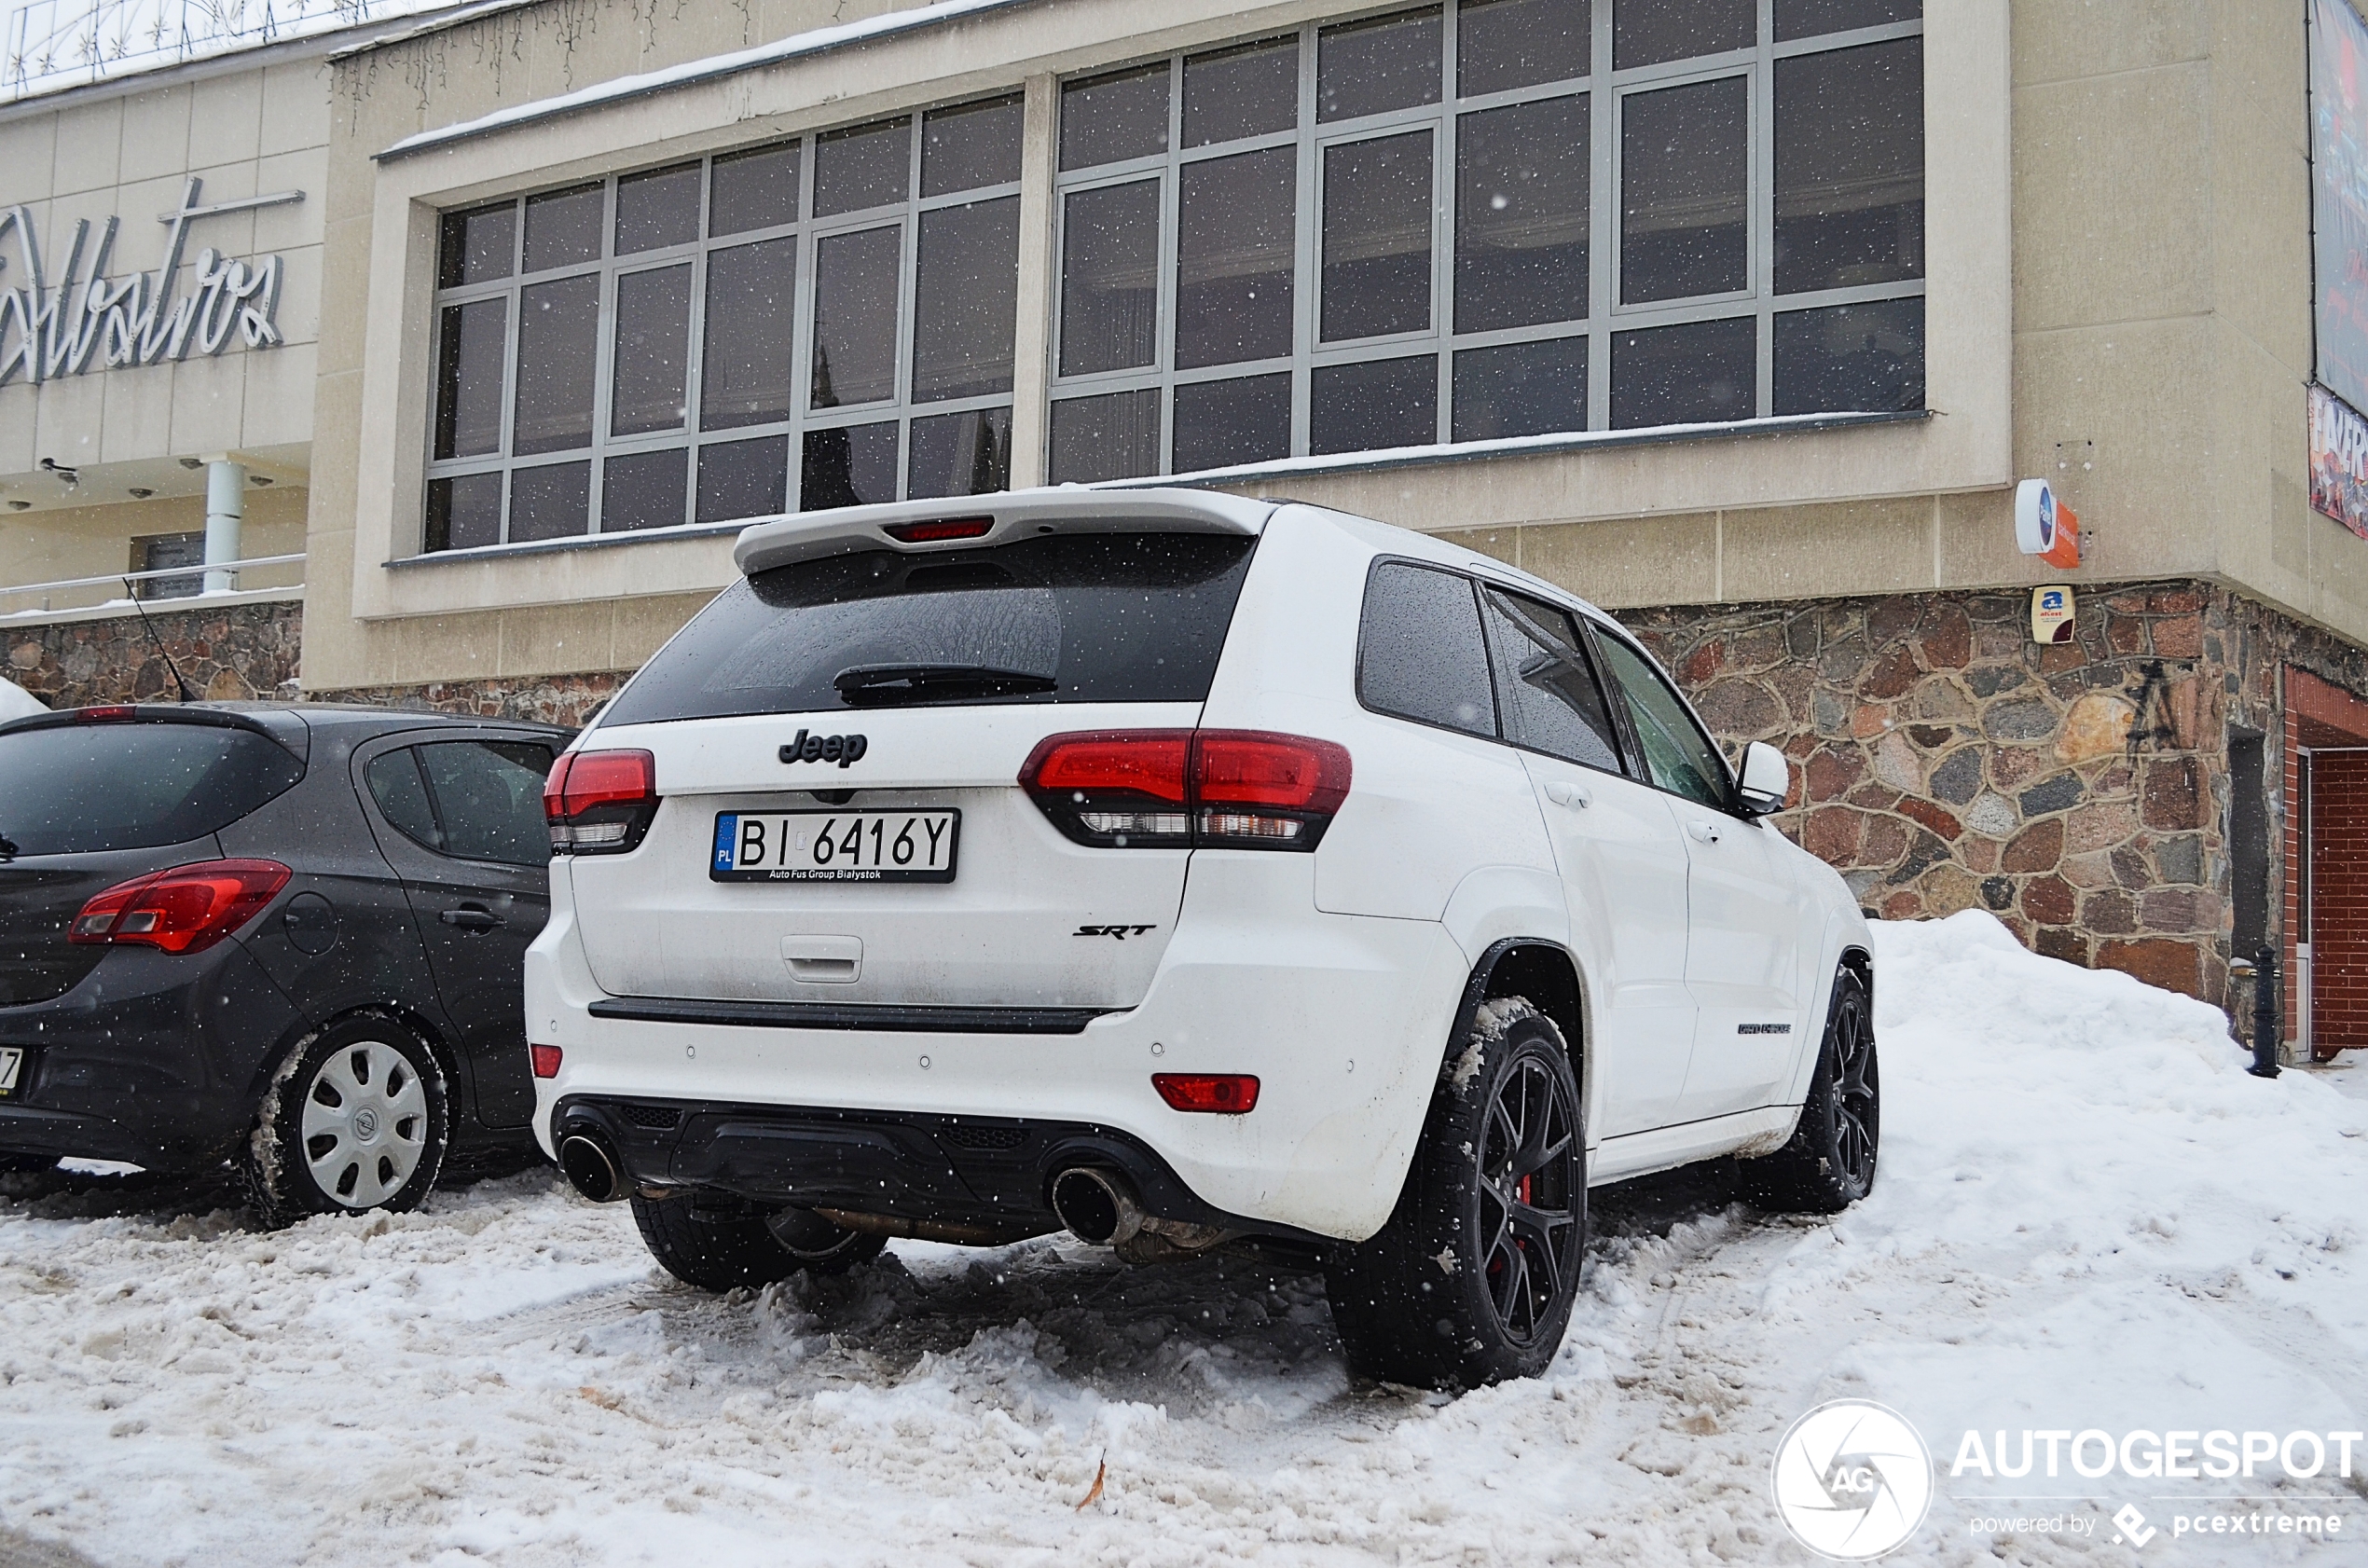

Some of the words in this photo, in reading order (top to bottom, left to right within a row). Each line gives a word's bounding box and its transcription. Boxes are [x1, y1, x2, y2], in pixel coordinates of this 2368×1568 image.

[0, 176, 306, 386] Albatros
[778, 729, 868, 768] Jeep
[718, 849, 732, 862] PL
[739, 818, 788, 866] BI
[813, 818, 948, 866] 6416Y
[769, 870, 790, 879] Auto
[792, 870, 806, 879] Fus
[808, 869, 834, 880] Group
[836, 869, 881, 880] Białystok
[1072, 924, 1157, 941] SRT
[0, 1051, 20, 1084] 7
